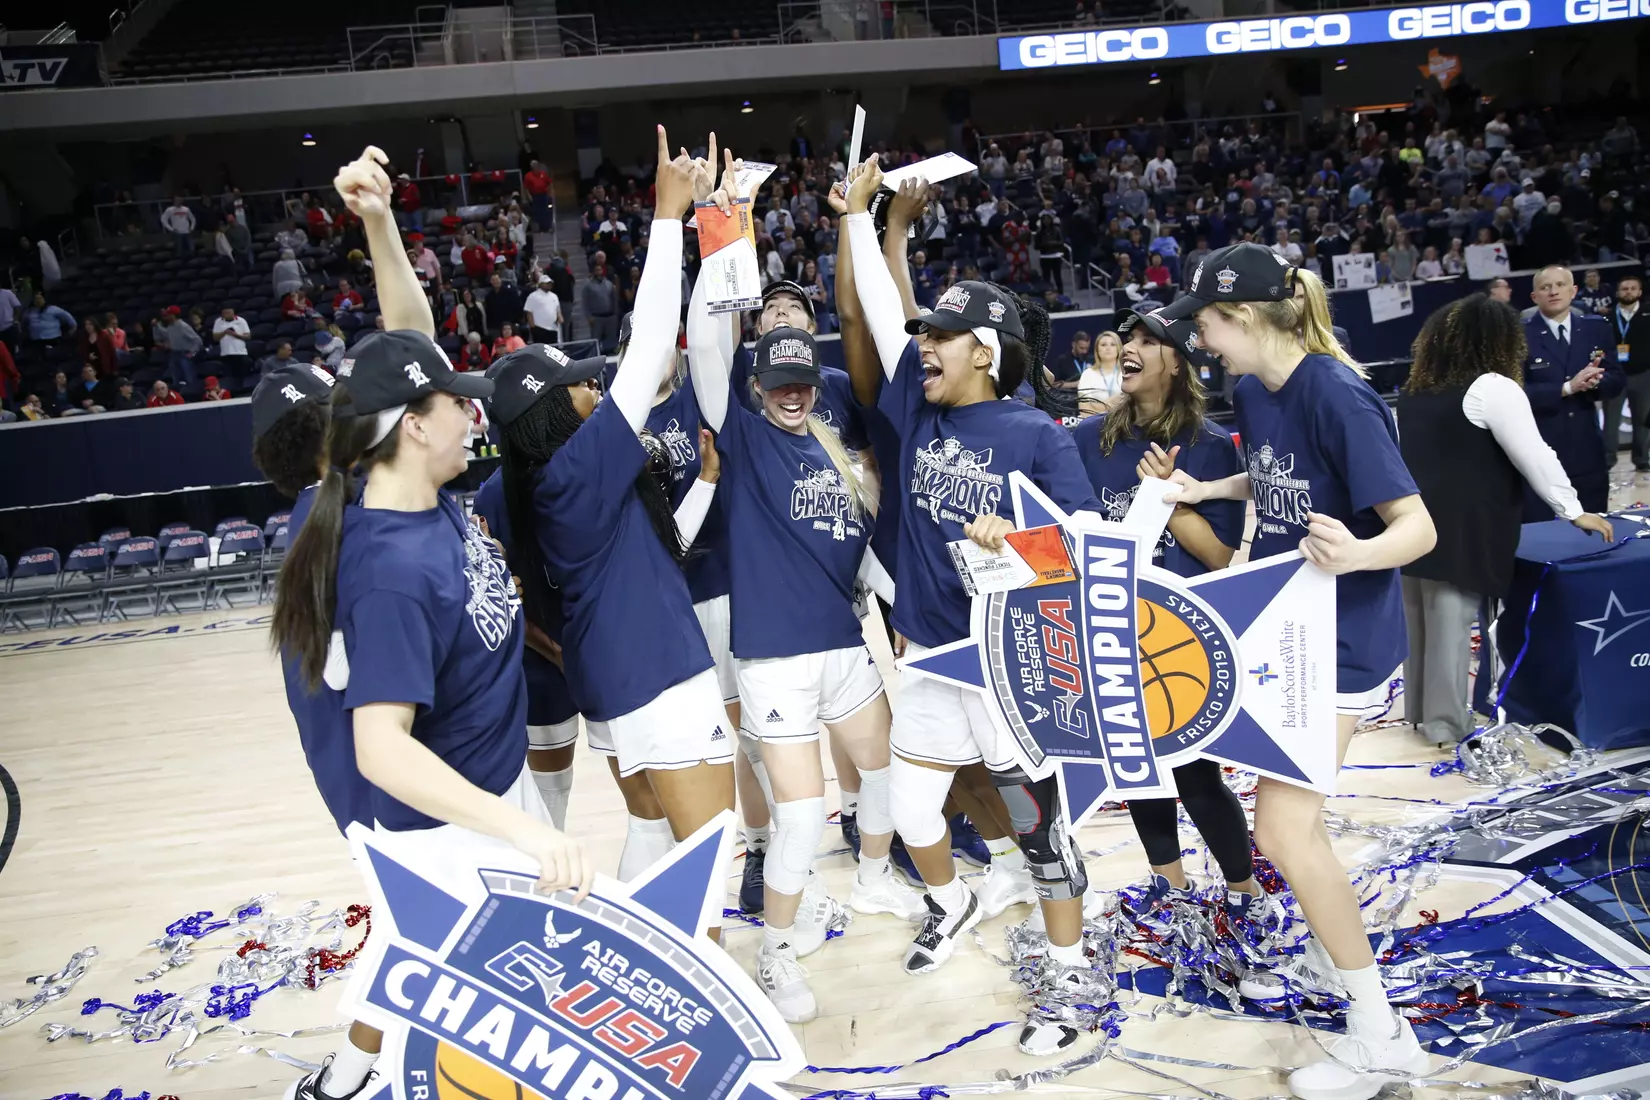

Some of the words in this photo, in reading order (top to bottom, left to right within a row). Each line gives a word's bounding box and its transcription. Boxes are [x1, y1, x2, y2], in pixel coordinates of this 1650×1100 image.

[1388, 0, 1531, 40] GEICO
[1565, 0, 1650, 24] GEI
[1019, 27, 1168, 67] GEICO
[1206, 14, 1350, 54] GEICO
[771, 345, 812, 360] CHAMPIONS
[1010, 607, 1029, 660] FORCE
[1165, 595, 1215, 640] TEXAS
[1023, 613, 1046, 692] RESERVE
[1088, 545, 1150, 783] CHAMPION
[1213, 650, 1229, 691] 2019
[1630, 653, 1650, 667] CO
[1020, 661, 1035, 696] AIR
[710, 734, 726, 742] adidas
[1177, 700, 1223, 744] FRISCO
[581, 956, 696, 1035] RESERVE
[582, 940, 630, 974] AIR
[630, 968, 714, 1027] FORCE
[384, 959, 645, 1100] CHAMP
[410, 1070, 429, 1100] FR
